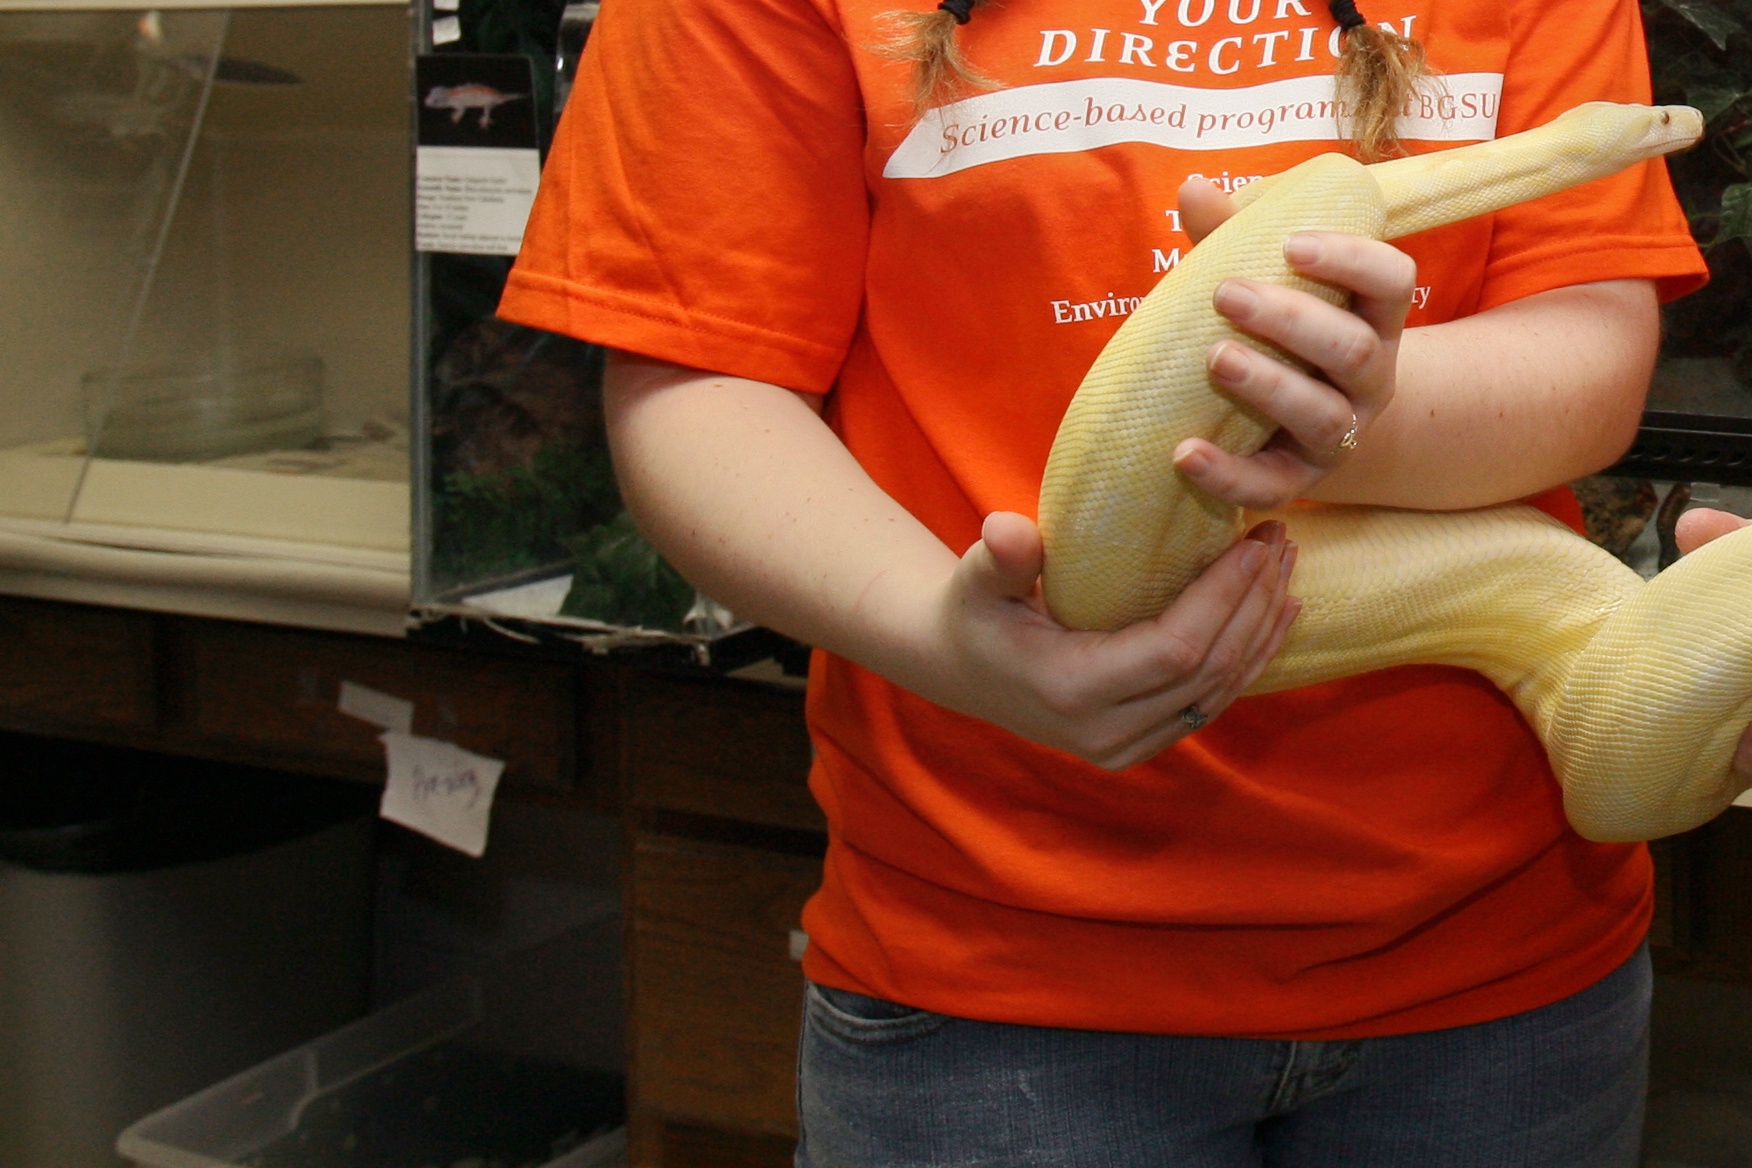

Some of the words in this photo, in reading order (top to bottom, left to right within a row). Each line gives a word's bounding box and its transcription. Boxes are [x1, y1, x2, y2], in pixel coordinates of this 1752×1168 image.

[939, 95, 1186, 155] Science-based
[1196, 100, 1352, 140] program
[1419, 92, 1497, 120] BGSU
